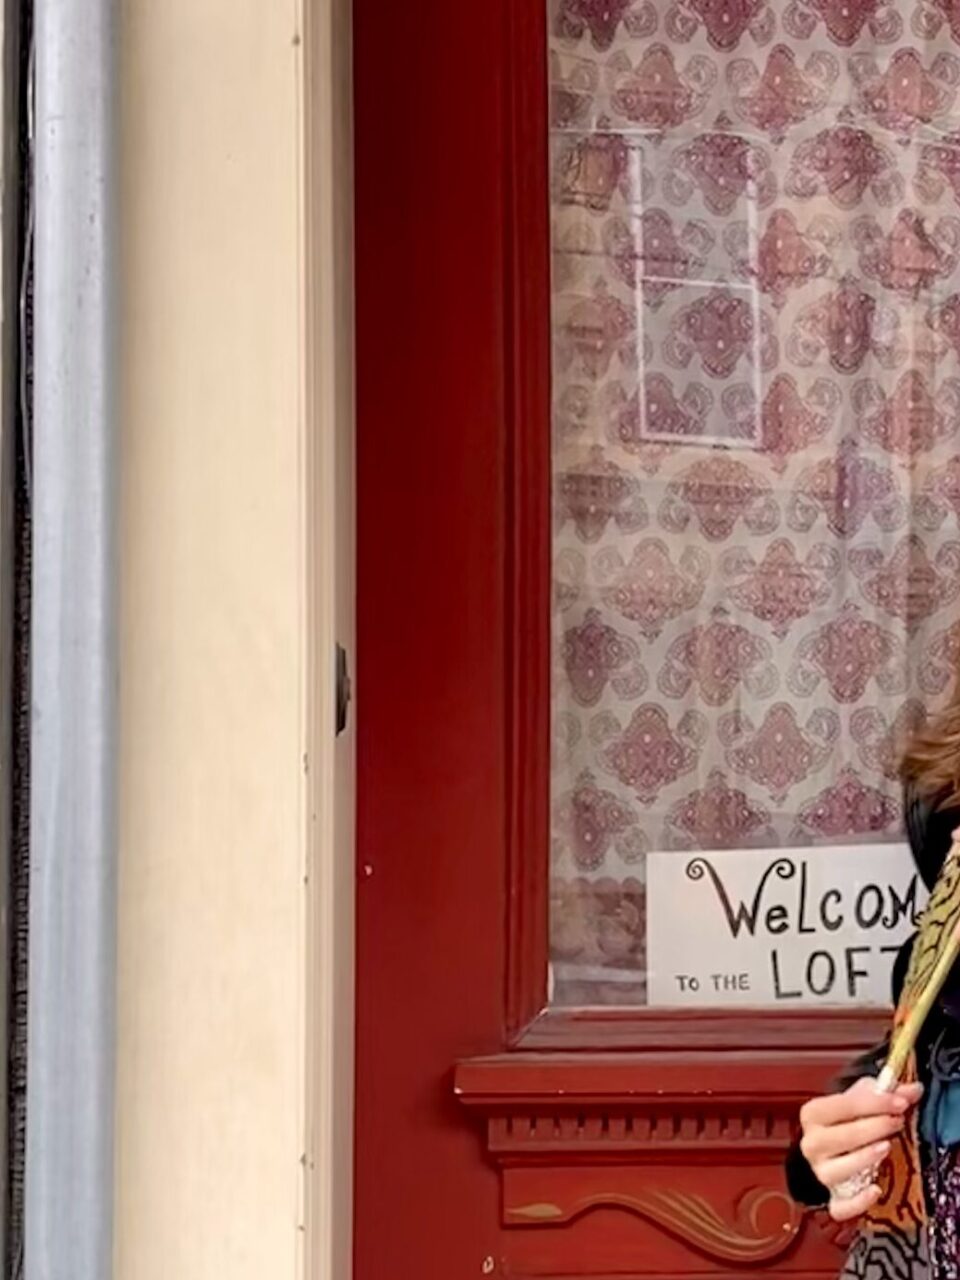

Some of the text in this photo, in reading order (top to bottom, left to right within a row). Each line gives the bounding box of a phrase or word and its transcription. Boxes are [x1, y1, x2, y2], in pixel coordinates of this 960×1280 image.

[685, 857, 921, 939] WeLCOM
[675, 945, 899, 999] TO THE LOF
